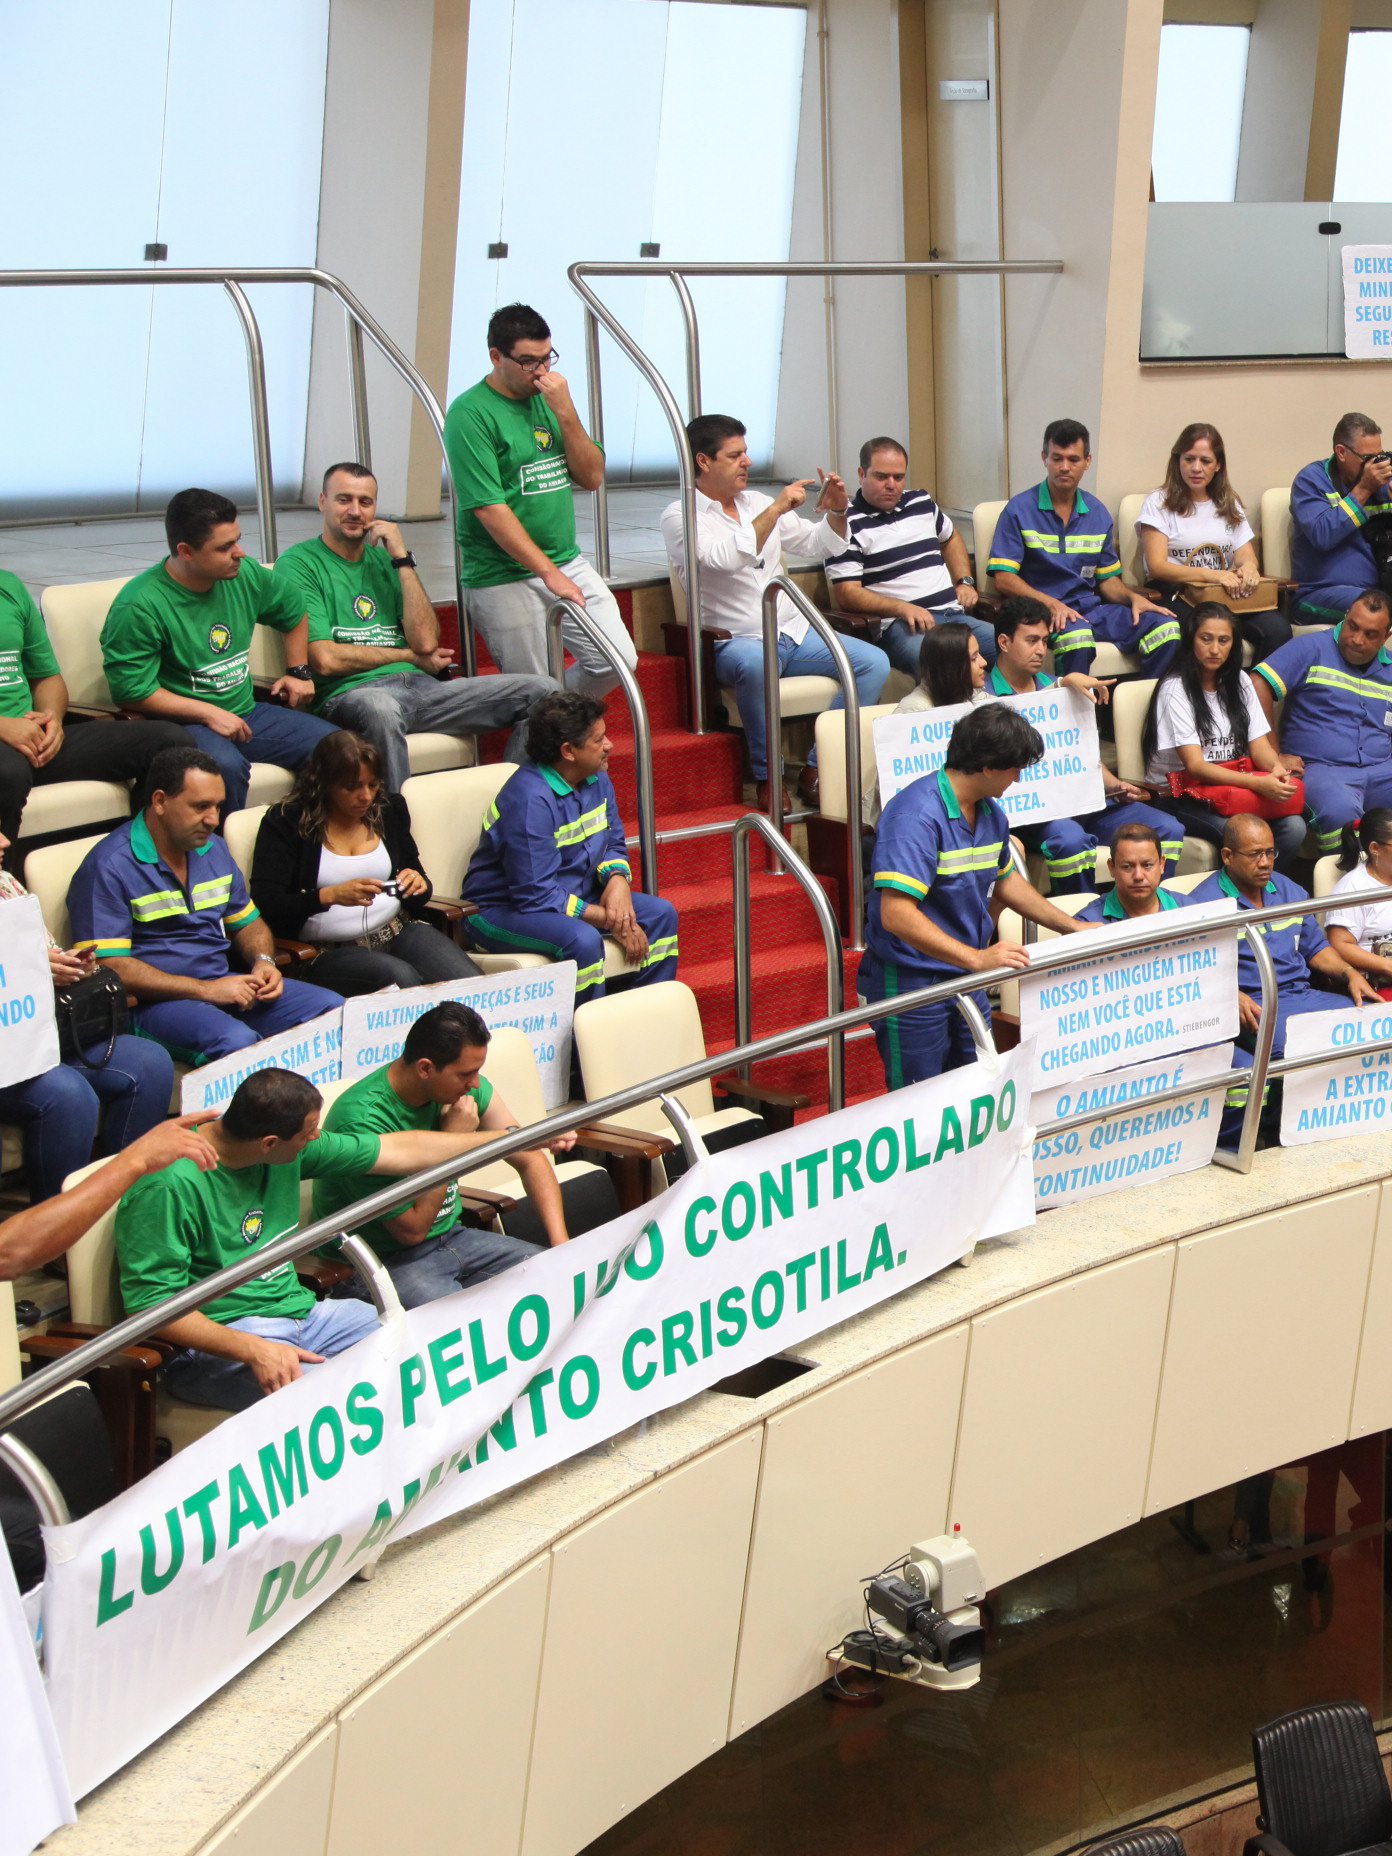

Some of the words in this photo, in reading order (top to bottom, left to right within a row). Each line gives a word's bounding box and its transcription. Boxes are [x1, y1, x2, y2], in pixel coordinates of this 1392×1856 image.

[911, 727, 919, 744] A
[923, 720, 955, 743] QUE
[1050, 704, 1058, 721] O
[1053, 754, 1087, 776] NÃO.
[514, 987, 521, 1003] E
[524, 981, 555, 1001] SEUS
[1040, 980, 1088, 1010] NOSSO
[1092, 976, 1099, 996] E
[1104, 957, 1174, 993] NINGUÉM
[1177, 947, 1217, 974] TIRA!
[550, 1012, 557, 1027] A
[1058, 1005, 1090, 1037] NEM
[1094, 995, 1130, 1025] VOCÊ
[1134, 990, 1163, 1017] QUE
[1168, 977, 1201, 1007] ESTÁ
[281, 1041, 309, 1070] SIM
[313, 1031, 322, 1058] É
[1041, 1032, 1121, 1072] CHEGANDO
[1125, 1018, 1180, 1049] AGORA.
[1183, 1017, 1220, 1033] STIEBENGOR
[1332, 1023, 1365, 1045] CDL
[1056, 1095, 1070, 1117] O
[1075, 1073, 1168, 1114] AMIANTO
[1326, 1078, 1337, 1100] A
[1090, 1102, 1195, 1150] QUEREMOS
[1197, 1098, 1209, 1120] A
[1297, 1097, 1385, 1131] AMIANTO
[96, 1381, 384, 1628] LUTAMOS
[400, 1294, 550, 1428] PELO
[685, 1079, 1016, 1258] CONTROLADO
[246, 1534, 343, 1646] DO
[622, 1222, 907, 1391] CRISOTILA.
